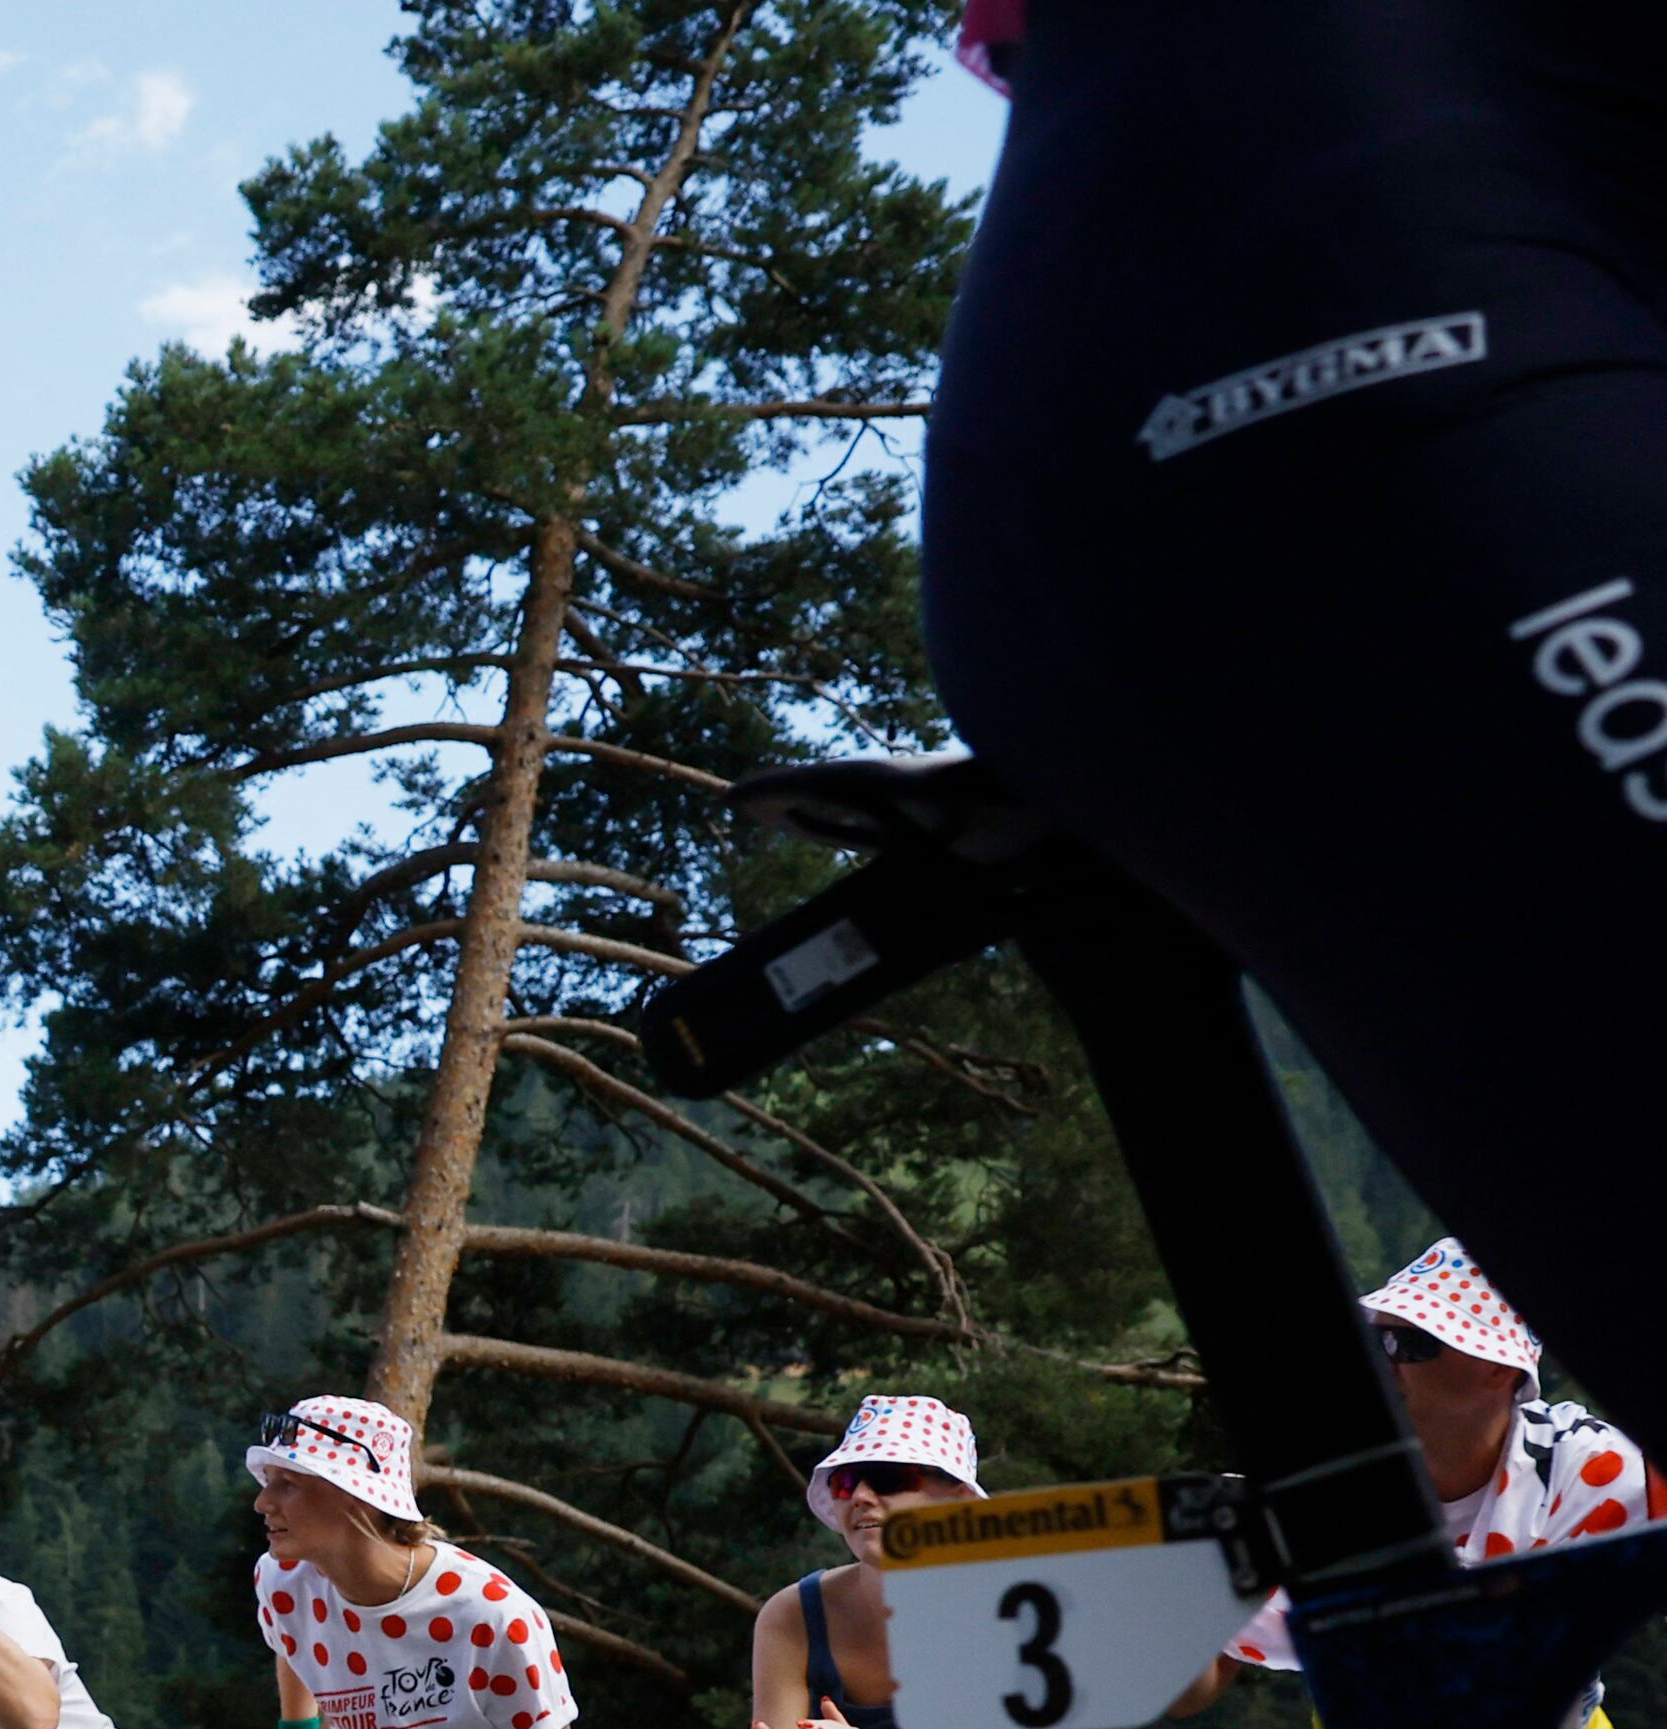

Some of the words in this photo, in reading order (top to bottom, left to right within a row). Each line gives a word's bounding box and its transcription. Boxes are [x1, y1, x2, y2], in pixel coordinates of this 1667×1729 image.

[1205, 328, 1465, 428] BYGMA
[882, 1493, 1108, 1560] Continental
[383, 1657, 455, 1695] TOUR
[997, 1581, 1074, 1729] 3
